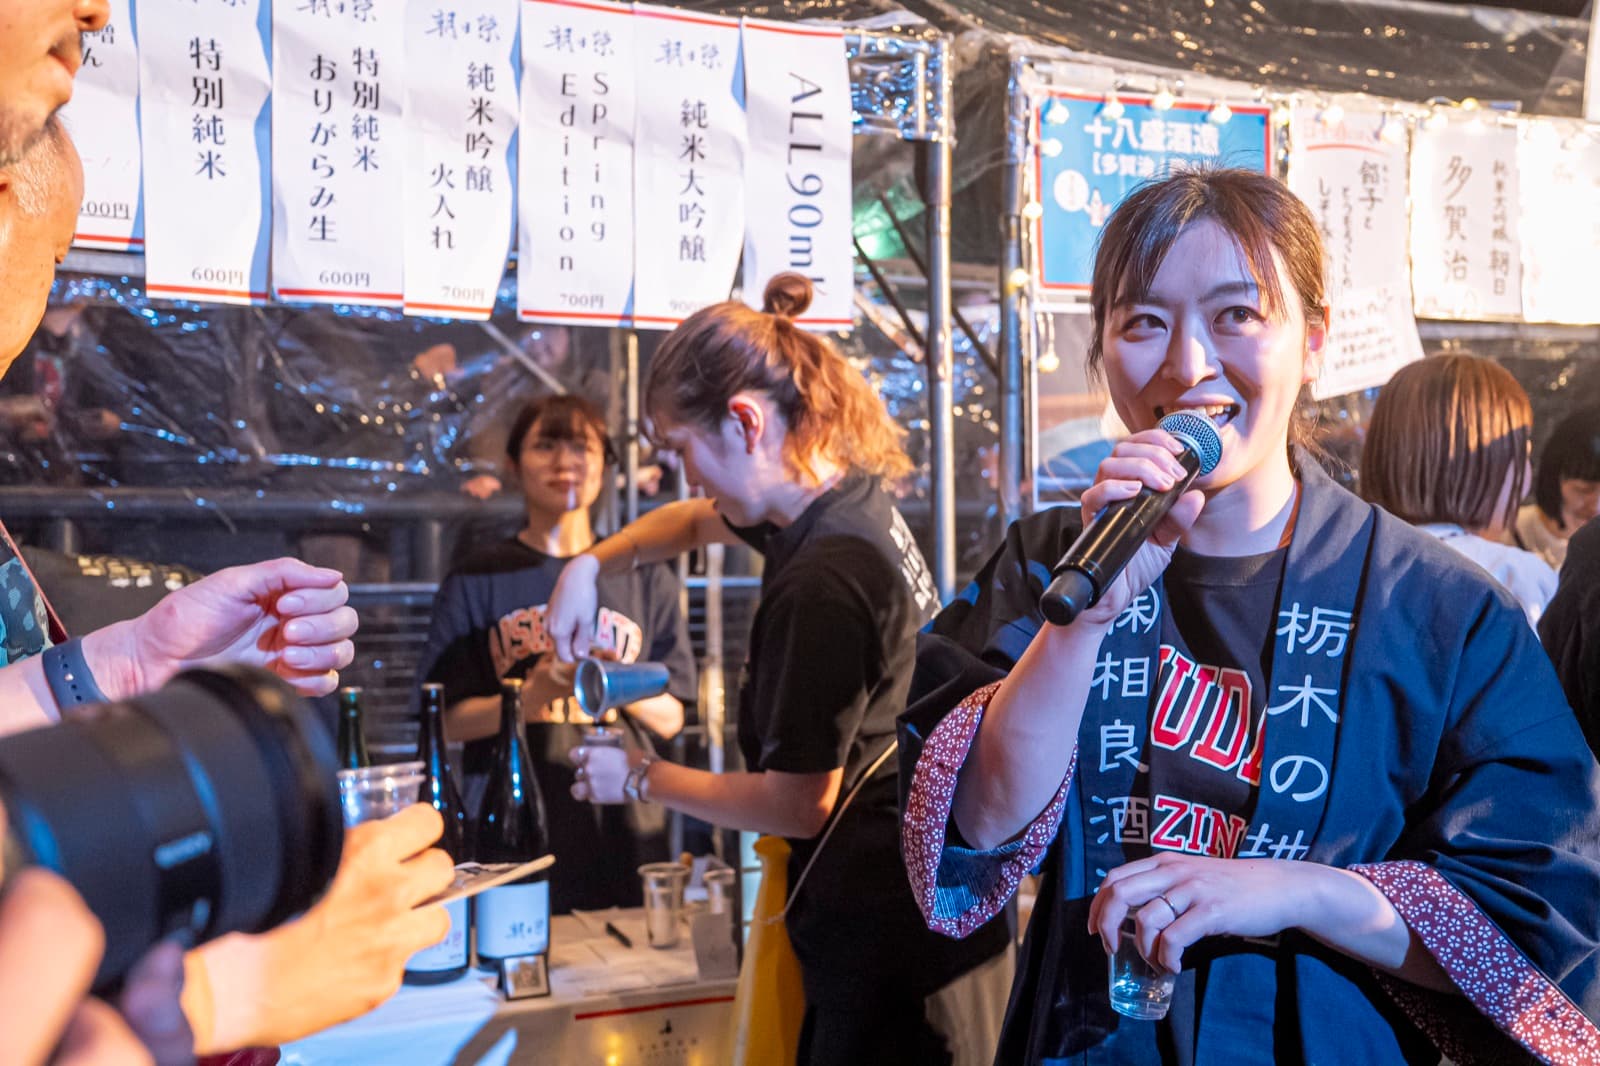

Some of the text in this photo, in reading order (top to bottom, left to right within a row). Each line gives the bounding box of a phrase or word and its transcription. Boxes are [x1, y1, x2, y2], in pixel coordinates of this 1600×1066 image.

[189, 37, 226, 180] 特別純米
[308, 54, 337, 243] おりがらみ生
[351, 47, 380, 173] 特別純米
[465, 62, 495, 193] 純米吟醸
[591, 72, 609, 242] Spring
[79, 201, 130, 219] 00円
[429, 163, 456, 250] 火入れ
[559, 73, 577, 272] Edition
[679, 99, 707, 263] 純米大吟醸
[1443, 155, 1473, 281] 多賀治
[191, 267, 244, 285] 600円
[318, 272, 371, 287] 600円
[441, 286, 485, 301] 700円
[557, 292, 605, 309] 700円
